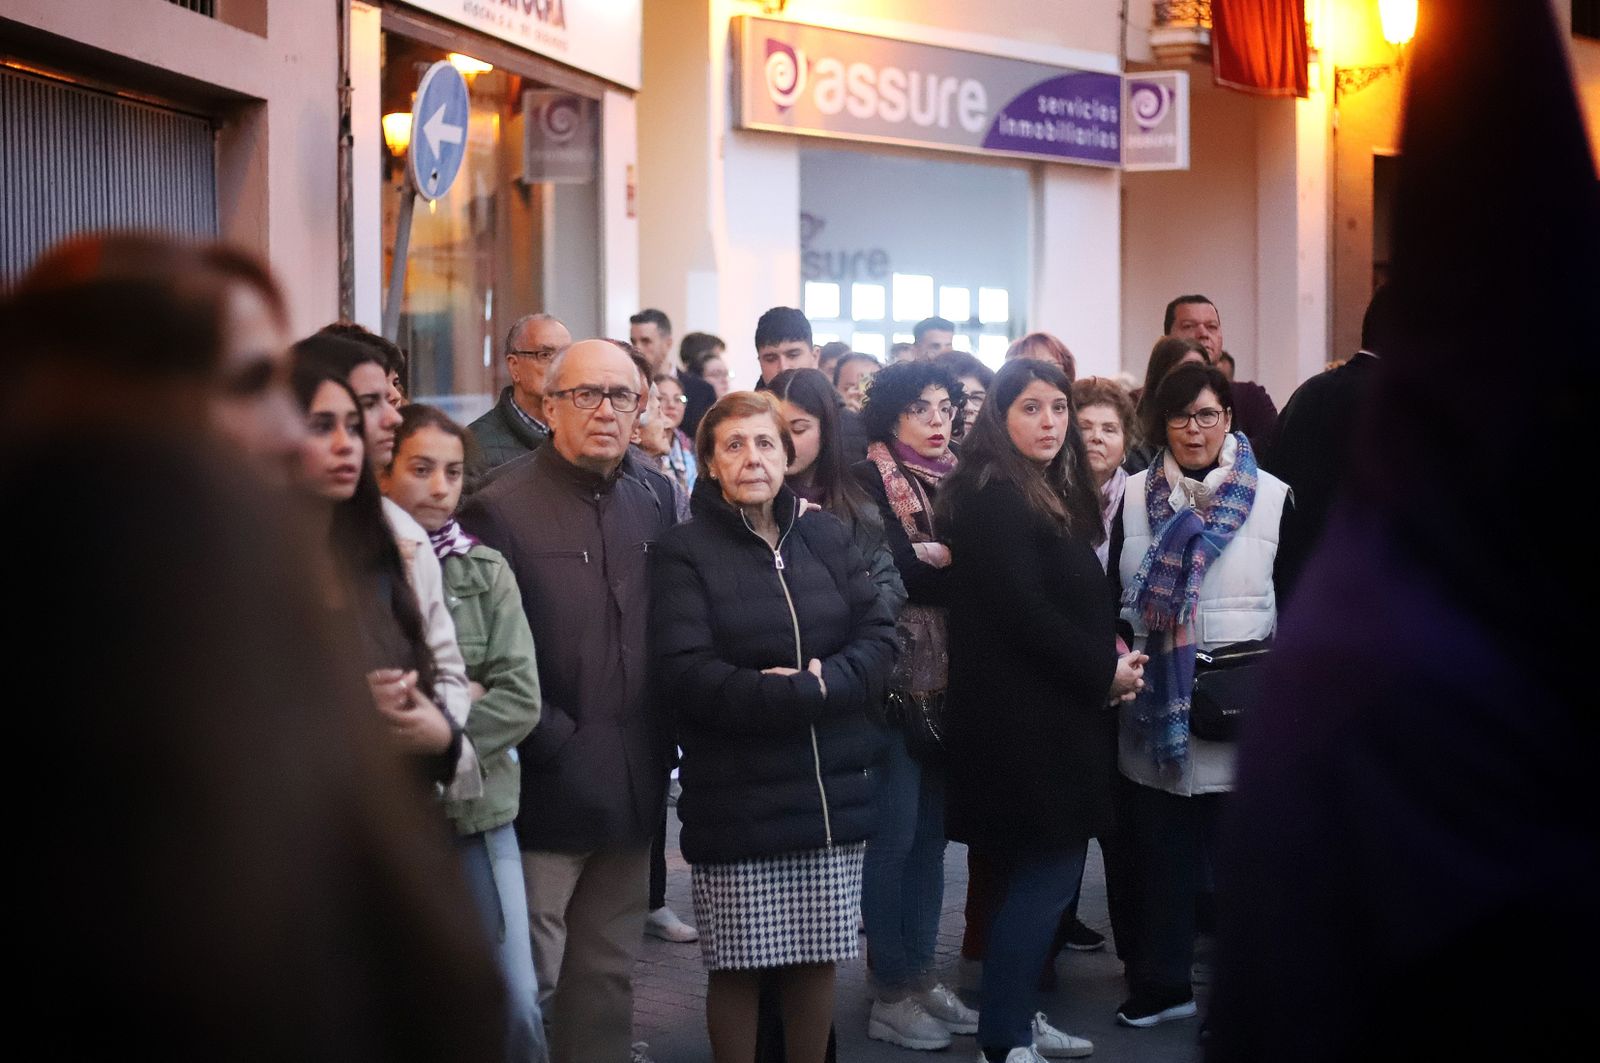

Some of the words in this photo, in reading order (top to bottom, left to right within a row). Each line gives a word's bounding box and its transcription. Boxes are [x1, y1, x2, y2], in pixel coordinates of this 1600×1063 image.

[814, 58, 987, 132] assure
[1037, 95, 1118, 123] servicios
[801, 249, 890, 279] sure
